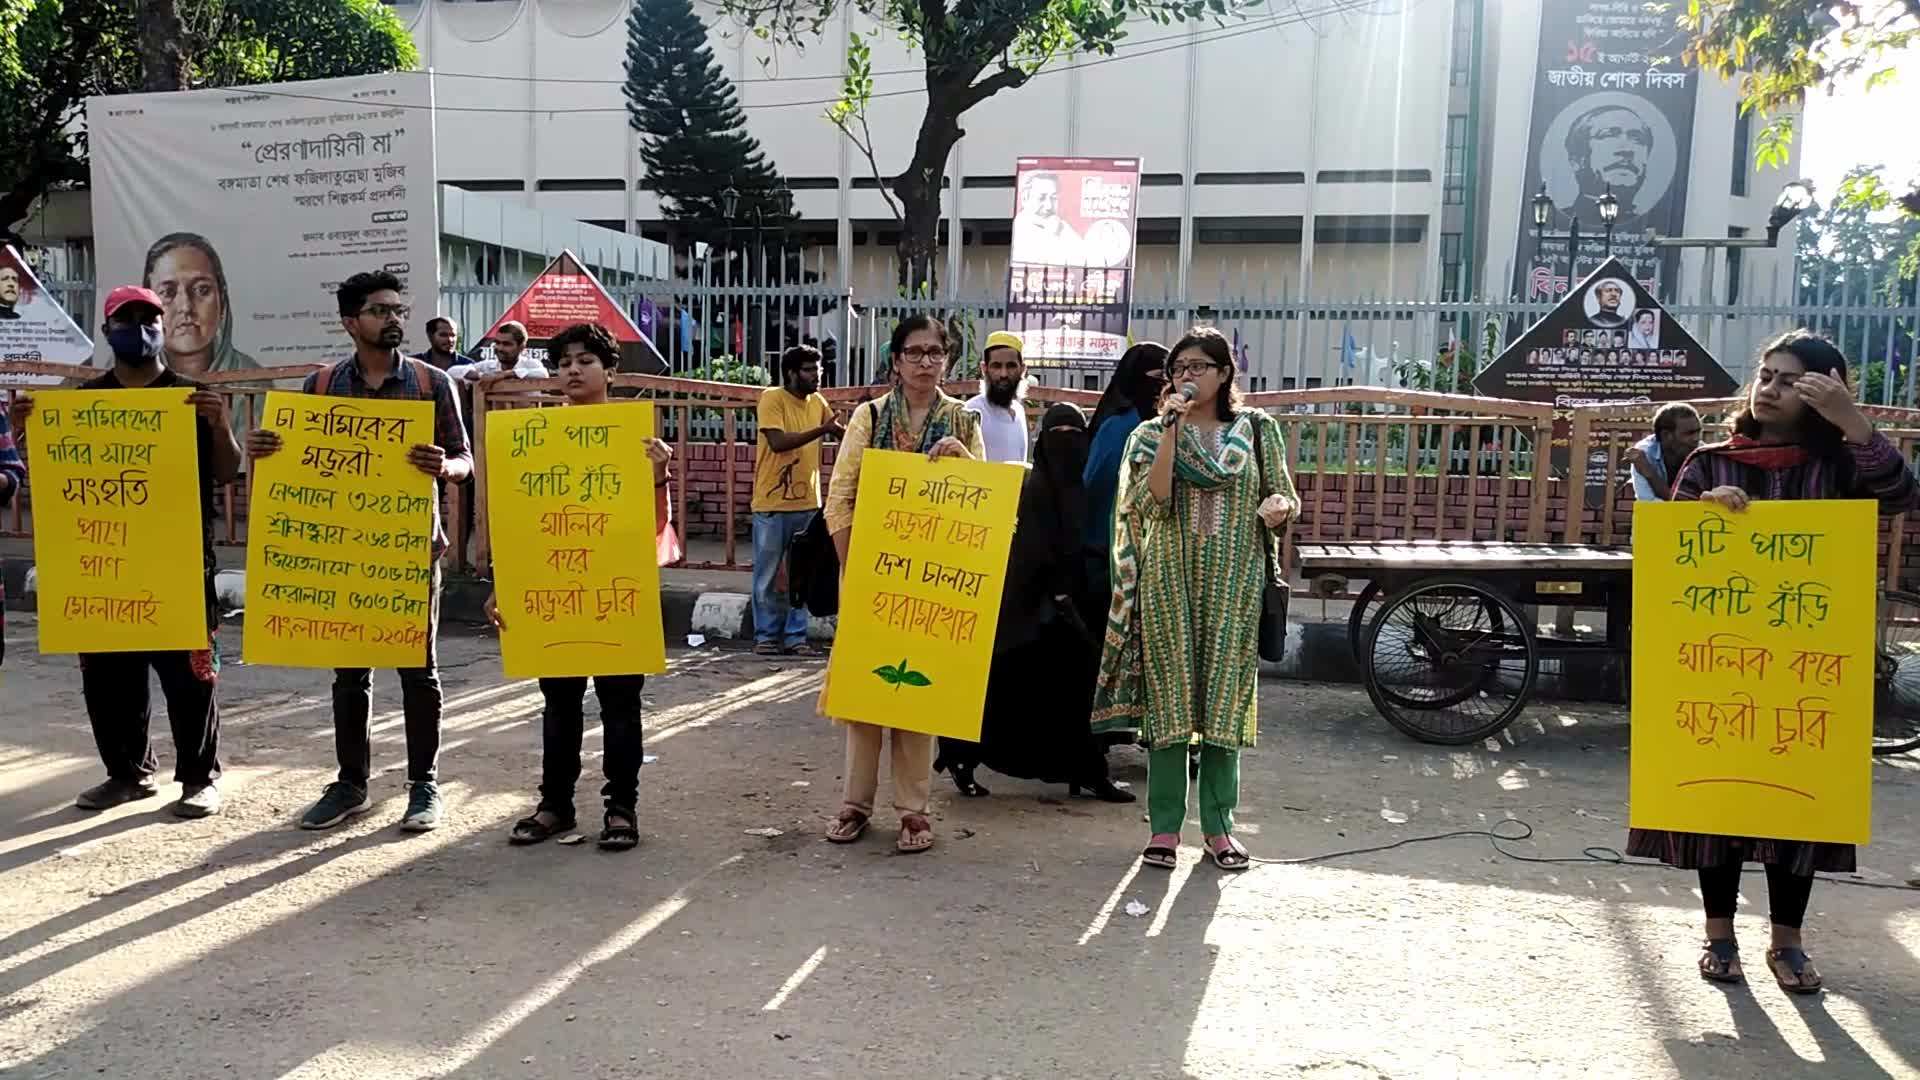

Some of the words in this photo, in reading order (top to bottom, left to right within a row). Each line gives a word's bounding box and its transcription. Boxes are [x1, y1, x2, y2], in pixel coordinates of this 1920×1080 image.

[1548, 65, 1597, 88] জাতীয়
[1600, 72, 1641, 89] শোক
[1646, 67, 1688, 89] দিবস
[217, 175, 262, 191] বঙ্গমাতা
[266, 174, 290, 189] শেখ
[373, 161, 406, 183] মুজিব
[294, 193, 325, 207] স্মরণে
[328, 188, 367, 207] শিল্পকর্ম
[369, 184, 406, 202] প্রদর্শনী
[43, 408, 60, 427] চা
[72, 400, 168, 432] শ্রমিকদের
[276, 408, 295, 430] চা
[304, 404, 414, 443] শ্রমিকের
[47, 436, 92, 466] দাবির
[100, 443, 158, 465] সাথে
[511, 413, 548, 457] দুটি
[564, 425, 620, 448] পাতা
[62, 469, 148, 507] সংহতি
[269, 482, 338, 513] নেপালে
[516, 462, 570, 496] একটি
[580, 464, 621, 502] কুঁড়ি
[888, 477, 907, 499] চা
[918, 475, 992, 510] মালিক
[77, 518, 127, 546] প্রাণে
[265, 512, 350, 546] শ্রীলঙ্কায়
[540, 505, 612, 536] মালিক
[883, 508, 944, 542] মজুরী
[946, 520, 992, 550] চোর
[1676, 510, 1737, 568] দুটি
[1750, 532, 1824, 566] পাতা
[80, 555, 125, 580] প্রাণ
[264, 544, 357, 576] ভিয়েতনামে
[547, 548, 594, 573] করে
[874, 552, 912, 580] দেশ
[922, 561, 989, 597] চালায়
[261, 584, 336, 610] কেরালায়
[524, 581, 588, 622] মজুরী
[595, 577, 640, 622] চুরি
[1672, 570, 1758, 616] একটি
[1766, 581, 1832, 630] কুঁড়ি
[264, 615, 364, 641] বাংলাদেশে
[873, 591, 978, 644] হারামখোর
[1678, 633, 1774, 680] মালিক
[1788, 651, 1850, 686] করে
[1676, 692, 1760, 748] মজুরী
[1769, 697, 1834, 755] চুরি
